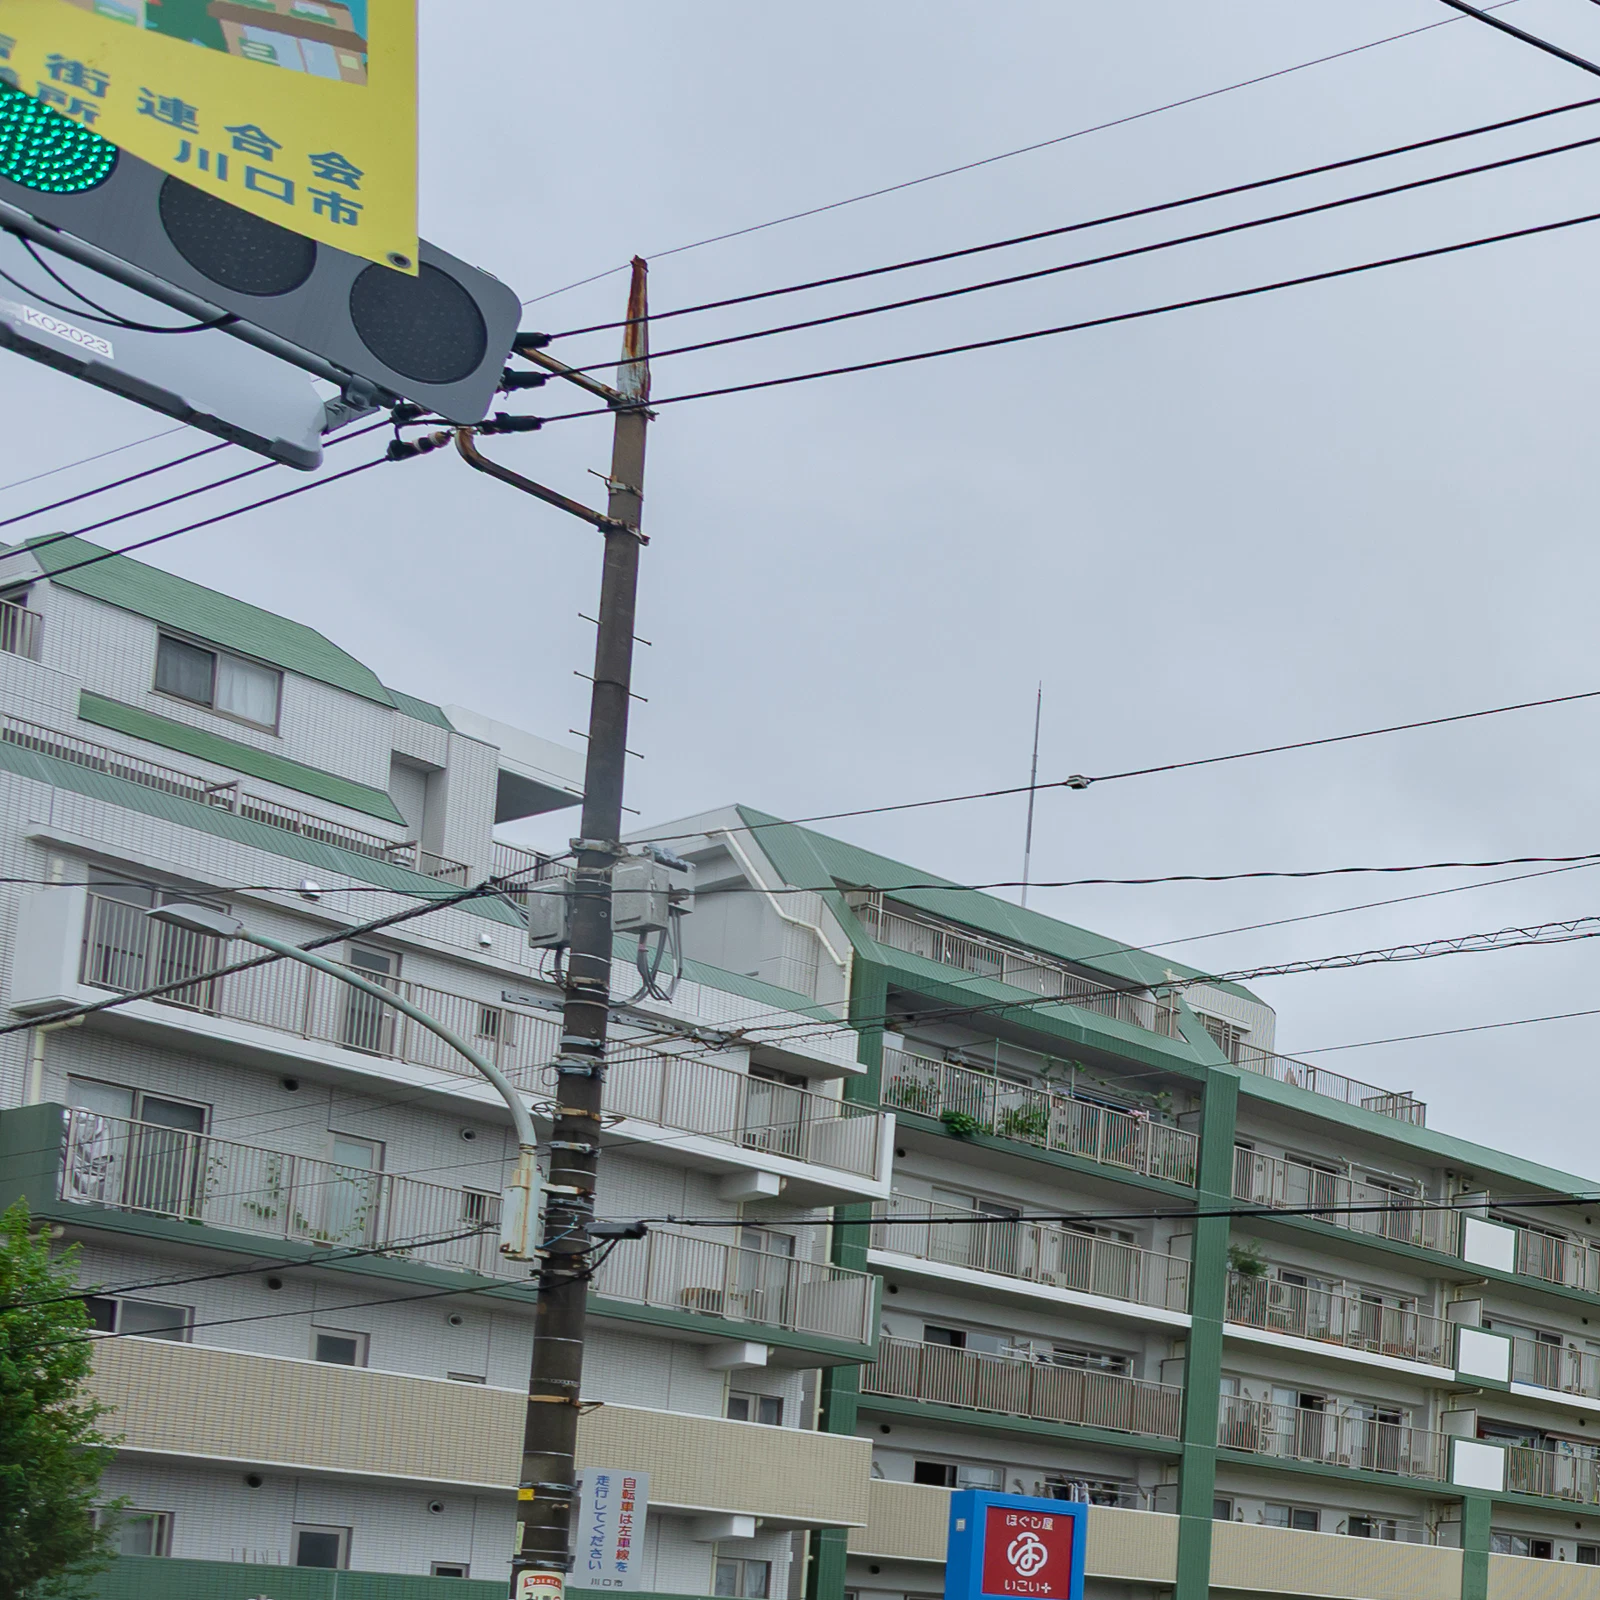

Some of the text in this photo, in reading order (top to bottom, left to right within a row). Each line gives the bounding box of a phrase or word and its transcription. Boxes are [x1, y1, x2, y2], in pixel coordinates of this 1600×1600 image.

[174, 139, 364, 227] 川口市
[588, 1475, 611, 1570] 走行してください
[614, 1477, 637, 1573] 自転車は左車線を
[1006, 1514, 1053, 1531] ほぐし屋
[591, 1578, 624, 1588] 川口市
